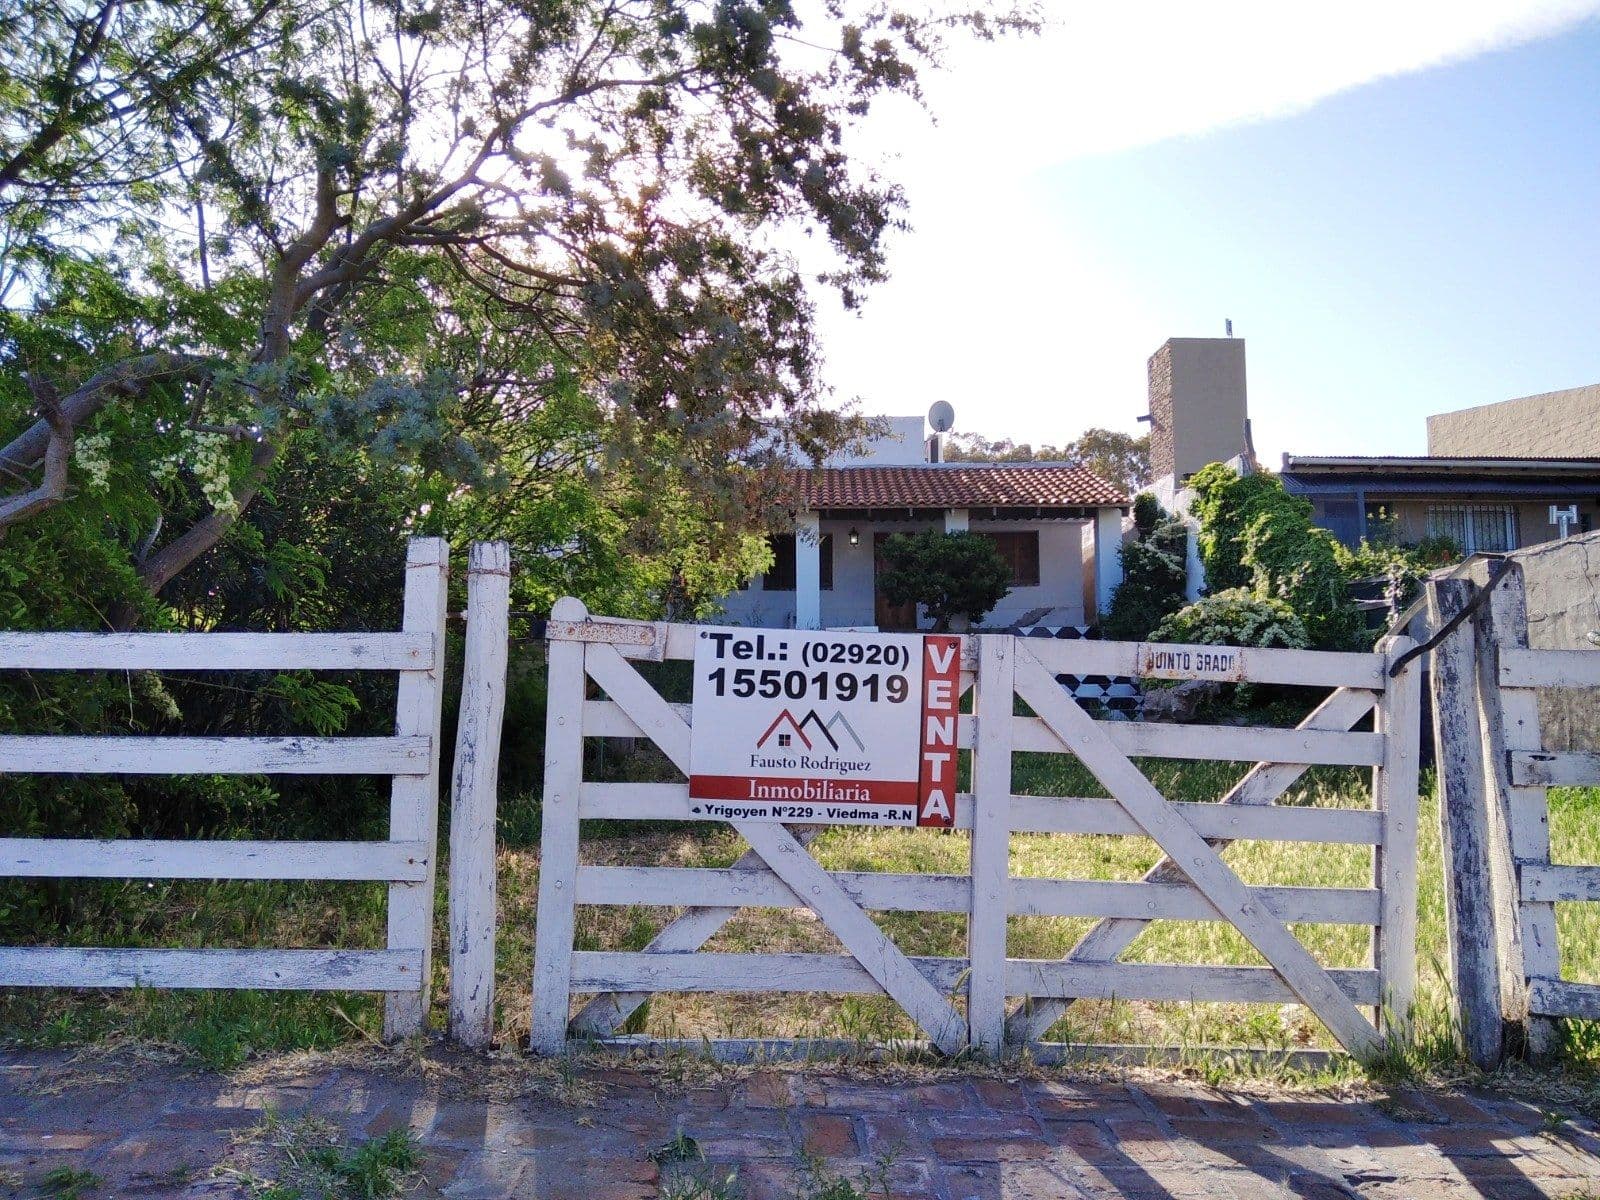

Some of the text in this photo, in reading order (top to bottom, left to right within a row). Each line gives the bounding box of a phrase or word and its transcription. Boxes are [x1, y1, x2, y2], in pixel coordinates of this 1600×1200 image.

[709, 633, 909, 671] Tel.: (02920)
[708, 667, 909, 704] 15501919
[921, 644, 954, 819] VENTA
[750, 754, 871, 775] Fausto Rodriguez
[749, 779, 870, 801] Inmobiliaria
[705, 804, 767, 819] Yrigoyen
[827, 808, 879, 820] Viedma
